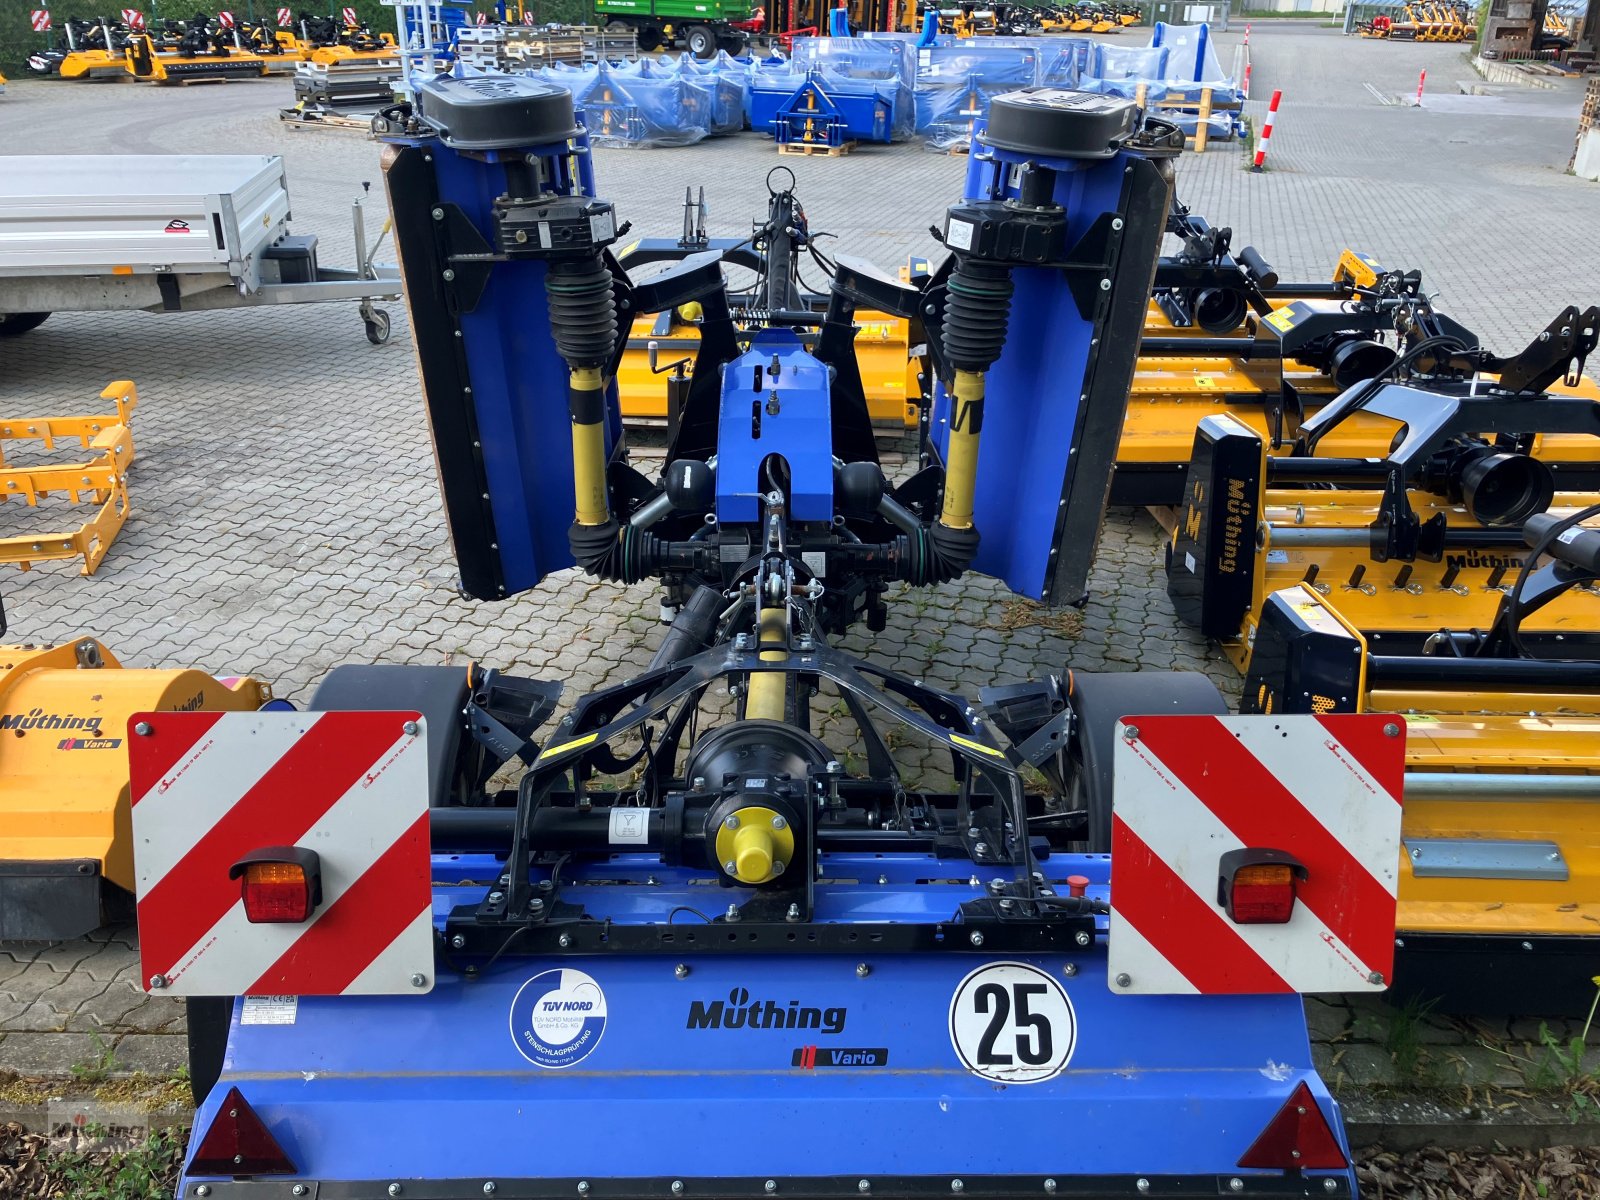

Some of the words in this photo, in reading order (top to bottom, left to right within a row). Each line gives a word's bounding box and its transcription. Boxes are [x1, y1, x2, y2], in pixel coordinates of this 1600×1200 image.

[1219, 478, 1251, 573] Müthing
[0, 708, 102, 731] Müthing
[83, 740, 113, 748] Vario
[543, 1002, 563, 1011] TÜV
[563, 1002, 593, 1011] NORD
[686, 987, 847, 1034] Müthing
[974, 983, 1053, 1066] 25
[524, 1029, 592, 1056] STEINSCHLAGPRÜFUNG
[831, 1050, 876, 1065] Vario
